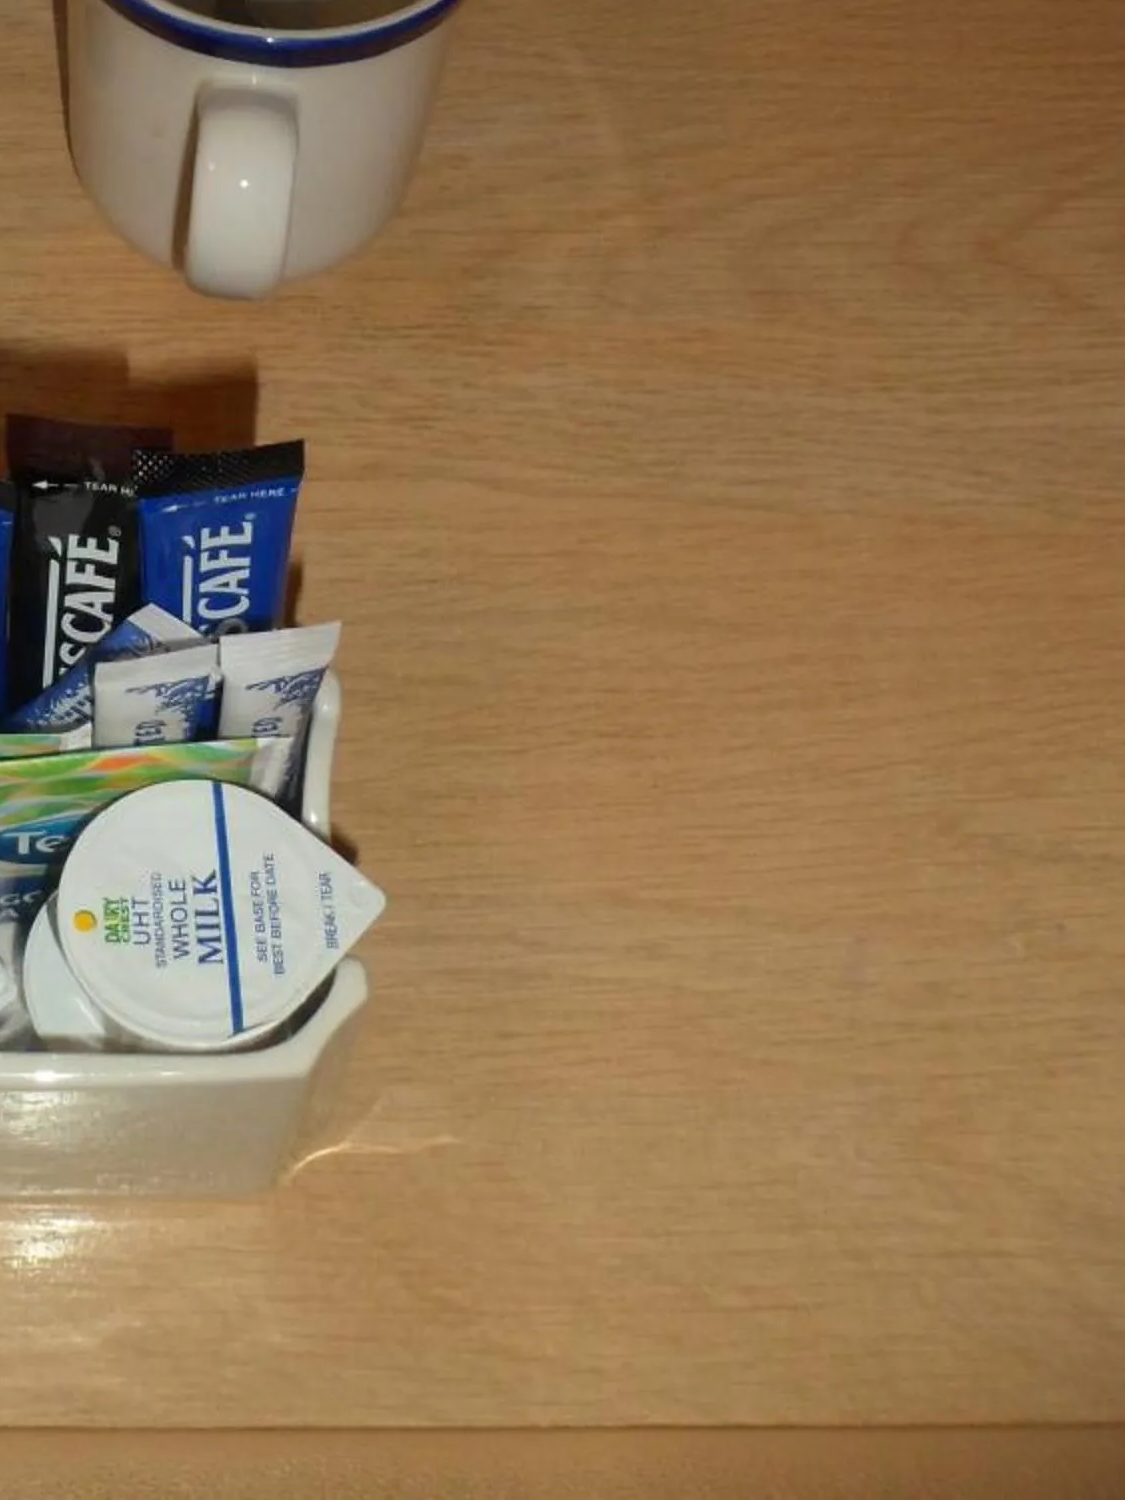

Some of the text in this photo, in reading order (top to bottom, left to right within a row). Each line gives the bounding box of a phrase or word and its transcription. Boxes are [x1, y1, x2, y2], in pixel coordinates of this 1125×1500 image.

[84, 481, 118, 493] TEAR
[213, 487, 285, 503] TEAR HERE
[45, 533, 120, 678] SCAFÉ
[318, 871, 333, 900] TEAR
[103, 896, 120, 944] DAIRY
[119, 897, 131, 944] CREST
[131, 895, 151, 945] UHT
[169, 878, 190, 960] WHOLE
[191, 869, 225, 964] MILK
[250, 870, 268, 962] SEE BASE FOR
[263, 852, 286, 975] BEST BEFORE DATE
[324, 909, 339, 950] BREAK
